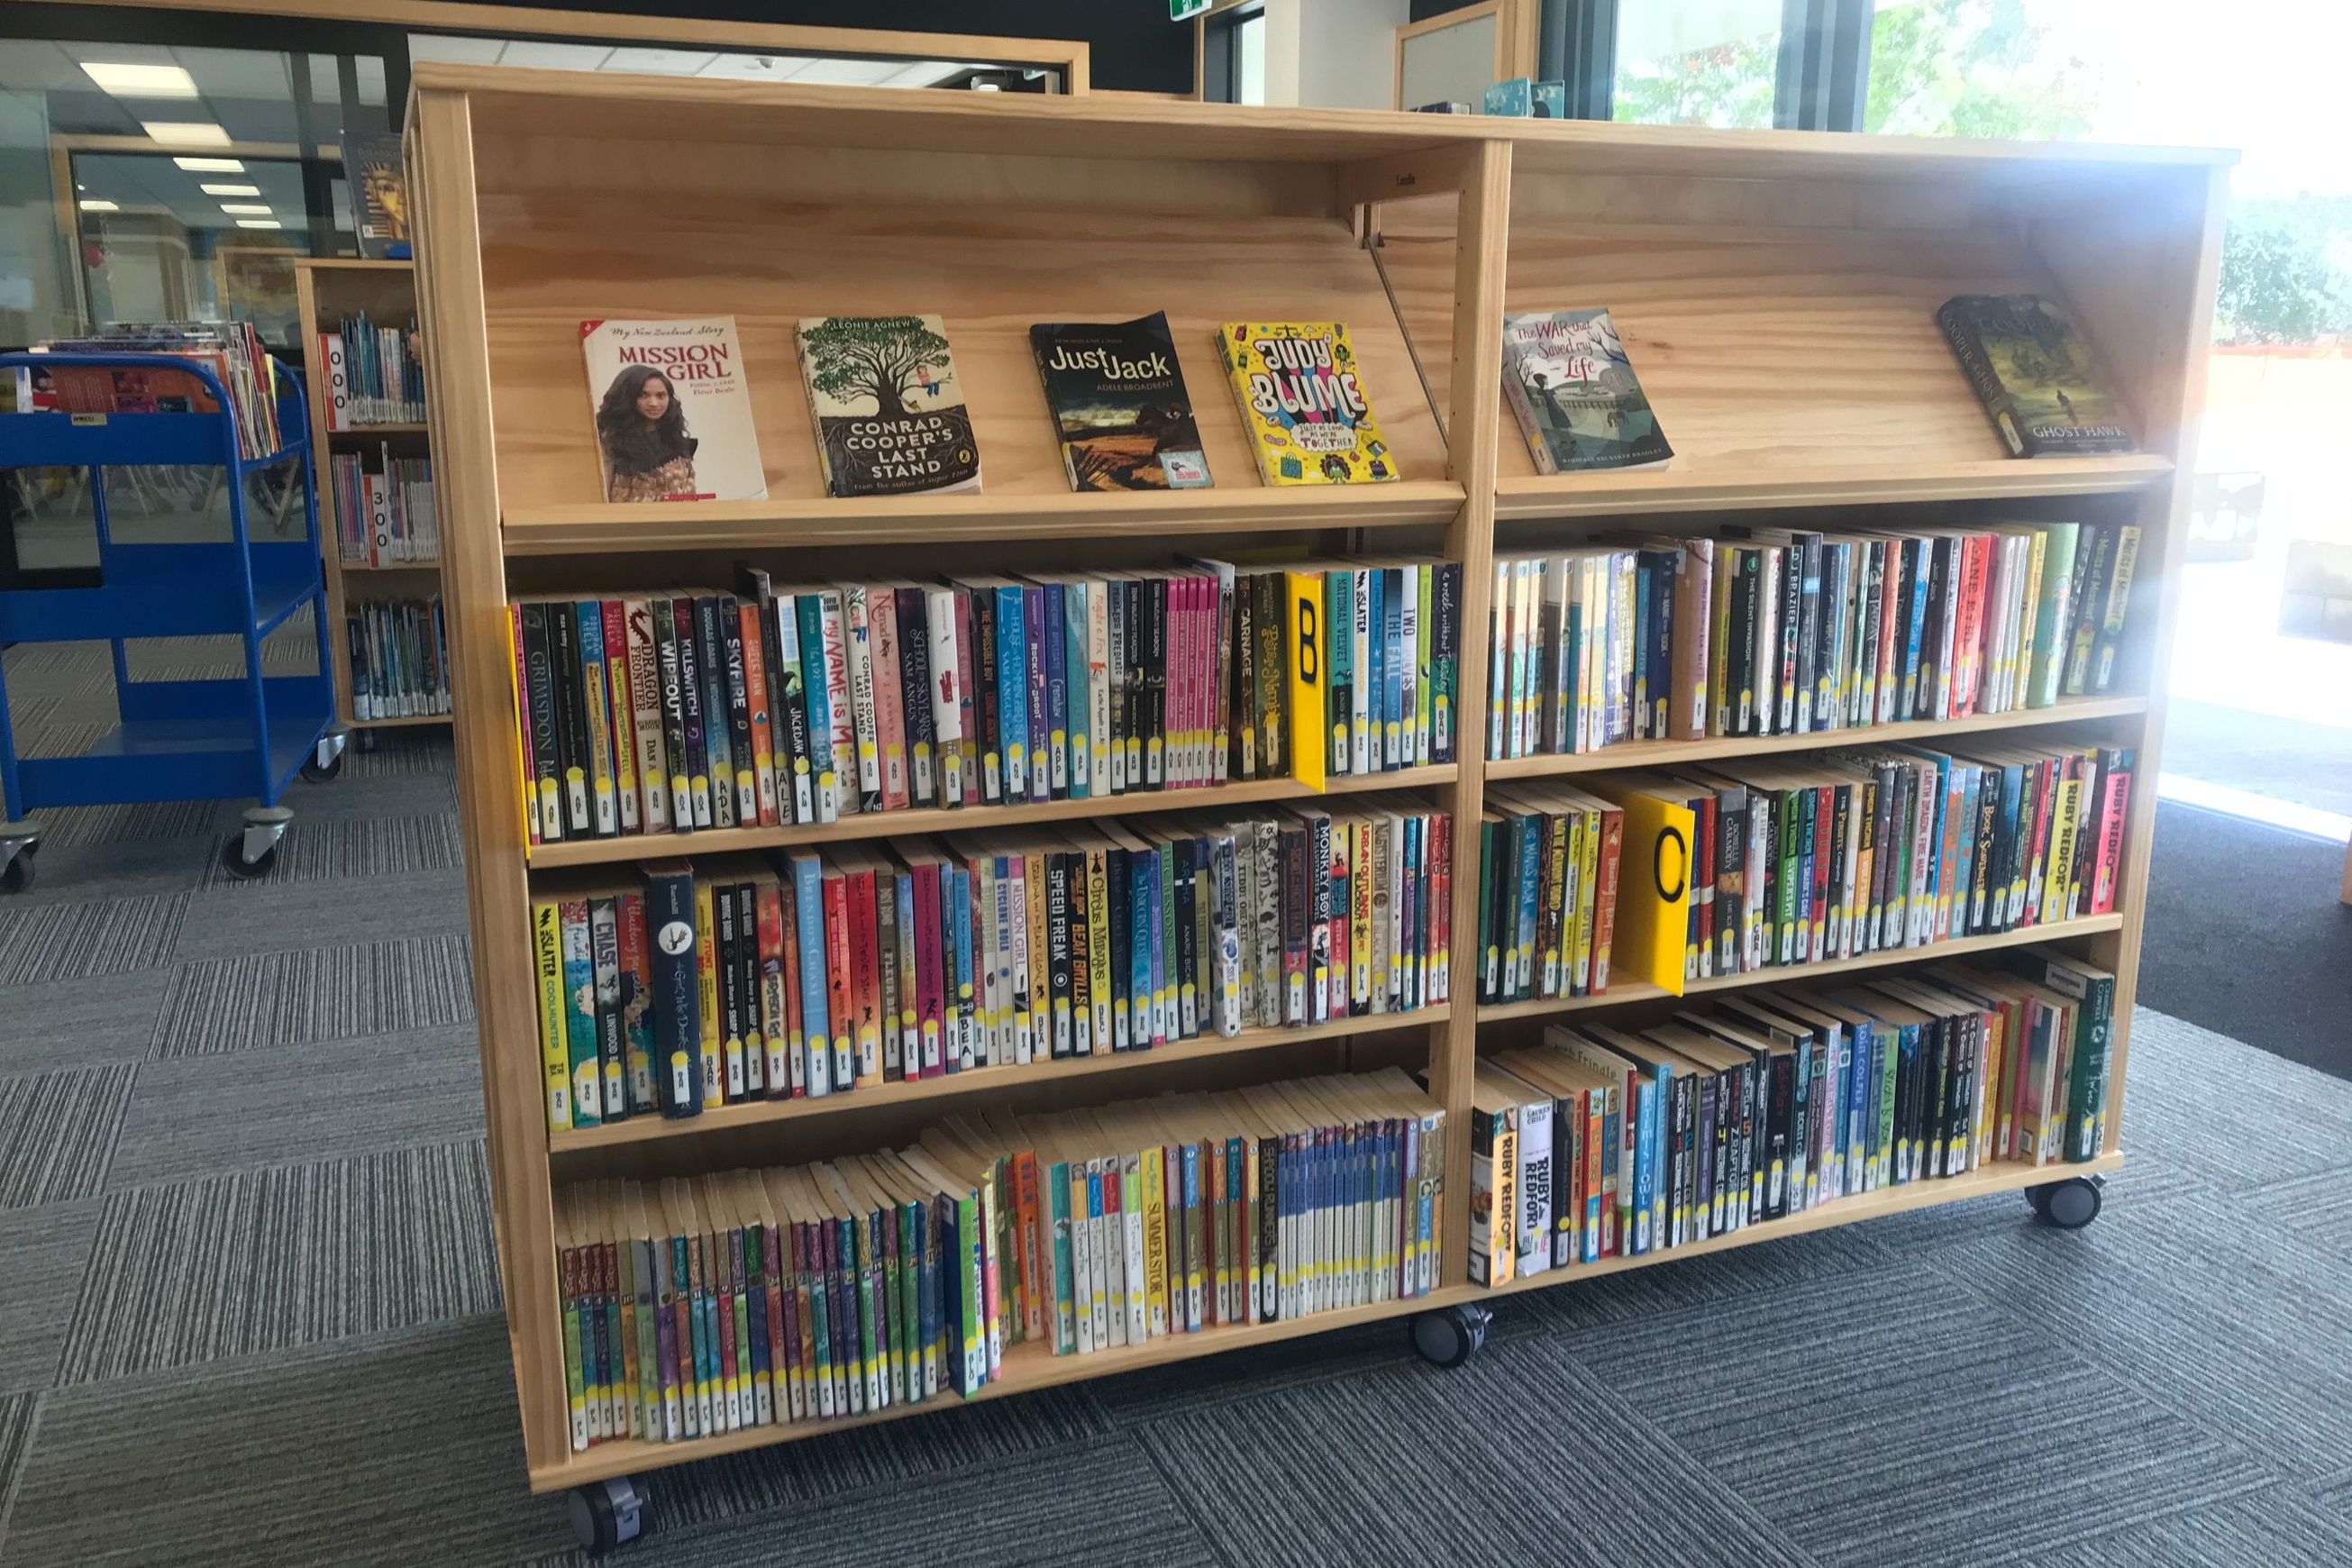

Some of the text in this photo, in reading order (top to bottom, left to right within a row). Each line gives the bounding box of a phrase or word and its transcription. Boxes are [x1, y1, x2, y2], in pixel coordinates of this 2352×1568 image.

[610, 327, 630, 340] My
[698, 325, 724, 337] Story
[833, 322, 870, 330] LEONIE
[1518, 321, 1592, 341] The WAR that
[1538, 338, 1592, 359] Saved my
[619, 343, 727, 363] MISSION
[666, 361, 731, 380] GIRL
[1050, 346, 1171, 379] Just Jack
[1254, 339, 1332, 369] JUDY
[1565, 356, 1597, 387] Life
[1124, 380, 1173, 390] BROADBENT
[1251, 372, 1366, 418] BLUME
[847, 428, 953, 449] COOPER'S
[851, 416, 942, 434] CONRAD
[1301, 437, 1353, 448] TOGETHER
[2033, 425, 2126, 438] GHOST HAWK
[871, 460, 941, 479] STAND
[879, 448, 926, 463] LAST
[1967, 544, 1981, 594] JANE
[871, 595, 890, 639] Nomad
[1336, 579, 1347, 663] NATIONAL VELVET
[1357, 597, 1366, 634] SLATER
[1403, 607, 1415, 636] TWO
[1788, 576, 1798, 624] BRAZIER
[1910, 588, 1923, 647] INVENTORY
[589, 615, 599, 655] DEBORAH
[703, 606, 716, 668] DOUGLAS ADAMS
[1112, 633, 1123, 676] FREDERIC
[1241, 607, 1252, 677] CARNAGE
[1299, 597, 1317, 684] B
[1387, 612, 1400, 679] THE FALL
[631, 646, 645, 711] FRONTIER
[642, 644, 658, 710] DRAGON
[661, 640, 680, 720] WIPEOUT
[681, 639, 697, 716] KILLSWITCH
[726, 638, 745, 708] SKYFIRE
[749, 640, 761, 696] SUPER FINN
[825, 640, 847, 719] NAME is
[861, 655, 871, 698] CONRAD
[904, 652, 916, 721] SAM ANGUS
[910, 628, 932, 743] SCHOOL SKYLARKS
[1030, 643, 1041, 719] ROCKET GROOT
[530, 652, 552, 751] GRIMSDON
[855, 676, 866, 734] LAST STAND
[1004, 679, 1012, 718] ANGUS
[1050, 679, 1063, 717] Crenshaw
[646, 739, 656, 761] DAN
[789, 707, 804, 752] JACKDAW
[720, 780, 733, 824] ADA
[778, 772, 789, 818] ALE
[1863, 785, 1875, 848] SIMON THORN
[2112, 776, 2127, 816] RUBY
[1724, 817, 1733, 871] CARMODY
[1765, 820, 1774, 868] CARMODY
[1837, 811, 1846, 850] PIRATE
[1915, 770, 1934, 880] EARTH FIRE HARE
[1975, 805, 1995, 891] BOOK SCAVENGER
[2056, 783, 2079, 893] RUBY REDFORT
[1319, 826, 1329, 919] MONKEY BOY
[1360, 825, 1370, 919] URBAN OUTLAWS
[1523, 843, 1536, 906] MINUS MUM
[1654, 826, 1686, 903] C
[1800, 791, 1815, 918] SIMON THORN SHARK'S CAVE
[670, 884, 679, 915] Barnhill
[1090, 878, 1105, 924] Circus
[1181, 861, 1190, 905] AROHA
[1238, 864, 1249, 942] TEDDY ONE-EYE
[1354, 872, 1362, 921] BLACKOUT
[1785, 868, 1794, 917] VIPER'S PIT
[804, 873, 816, 946] BRENDON
[997, 884, 1009, 952] CYCLONE BOLA
[1012, 884, 1026, 970] MISSION GIRL
[1051, 870, 1066, 961] SPEED FREAK
[1135, 886, 1148, 959] UNICORN QUEST
[1163, 882, 1172, 938] BESSON
[705, 939, 713, 970] STUNT
[884, 953, 895, 996] FLEUR
[1072, 924, 1088, 1005] BEAR GRYLLS
[540, 937, 560, 1049] SLATER COOLHUNTER
[595, 922, 618, 1053] CHASE LINWOOD
[2094, 983, 2104, 1021] COWELL
[728, 1009, 737, 1030] SHARP
[748, 1004, 757, 1026] SHARP
[959, 1020, 971, 1056] BEA
[1578, 1051, 1617, 1079] Frindle
[1855, 1023, 1868, 1105] EOIN COLFER
[1527, 1107, 1551, 1117] LAUREN
[1527, 1115, 1546, 1125] CHILD
[1502, 1135, 1512, 1180] RUBY
[1683, 1150, 1692, 1188] SUZANNE
[1717, 1145, 1726, 1181] SUZANNE
[1741, 1138, 1750, 1174] SUZANNE
[1526, 1162, 1537, 1230] REDFORT
[1537, 1156, 1549, 1205] RUBY
[1147, 1202, 1162, 1261] SUMMER
[1264, 1193, 1275, 1245] RUNNERS
